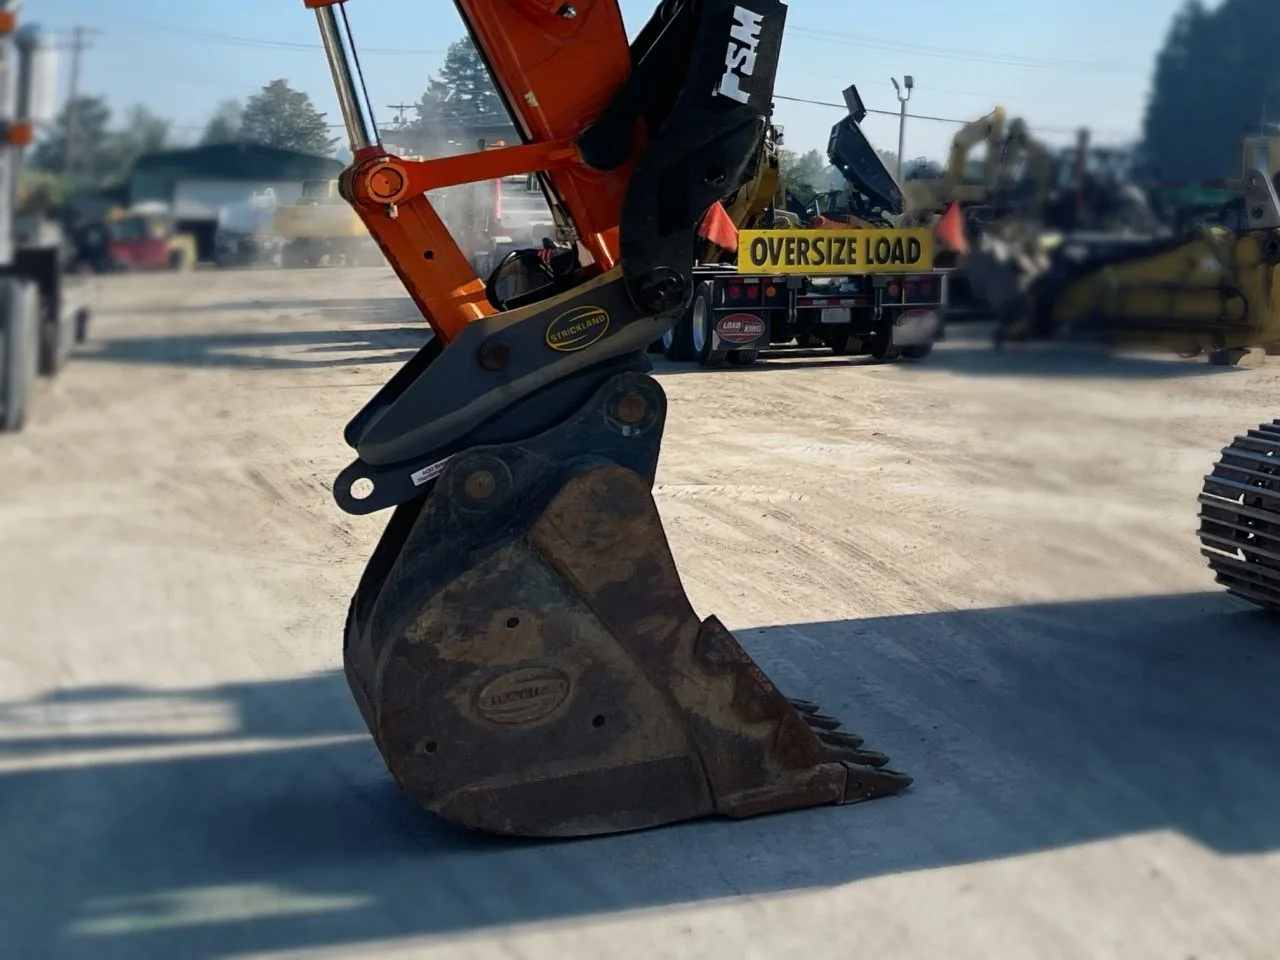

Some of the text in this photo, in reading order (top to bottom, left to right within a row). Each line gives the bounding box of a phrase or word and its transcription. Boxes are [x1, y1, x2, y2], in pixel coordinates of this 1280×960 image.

[718, 4, 764, 104] PSM
[750, 236, 921, 267] OVERSIZE LOAD
[550, 314, 606, 342] STRICKLAND
[723, 321, 741, 329] LOAD
[744, 325, 762, 333] KING
